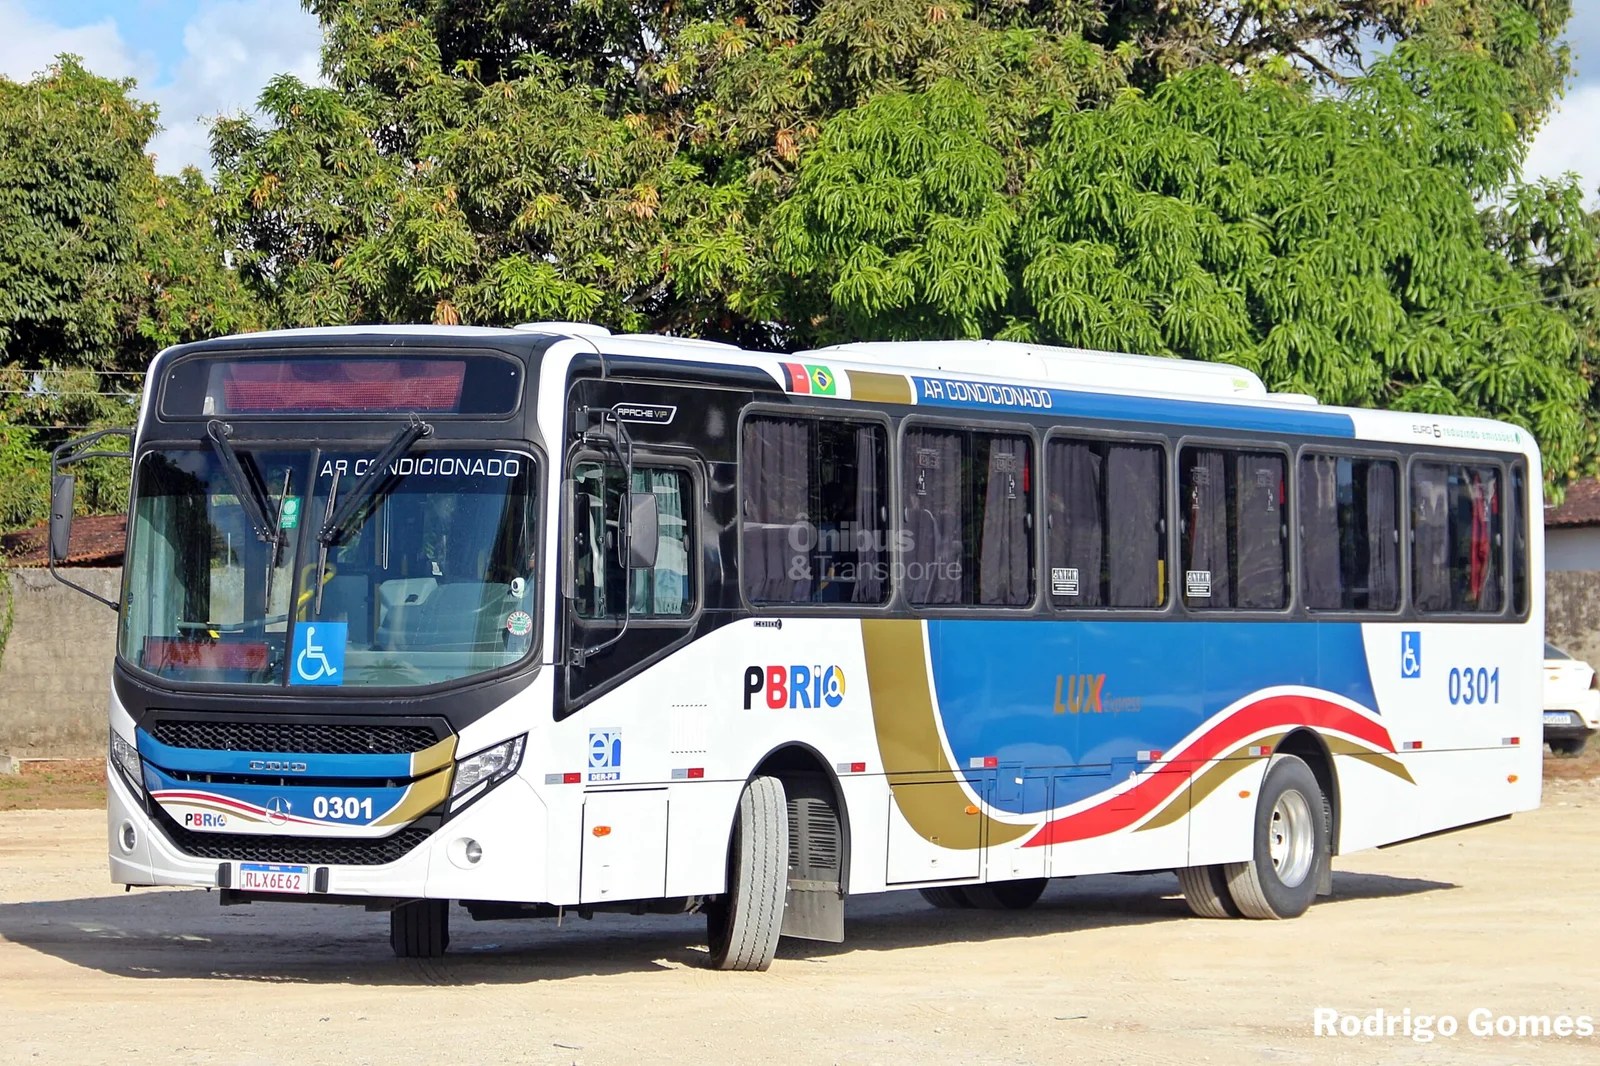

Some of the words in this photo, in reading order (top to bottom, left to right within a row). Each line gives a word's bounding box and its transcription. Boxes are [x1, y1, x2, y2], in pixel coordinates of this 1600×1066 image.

[923, 379, 944, 399] AR
[945, 381, 1052, 408] CONDICIONADO
[617, 408, 653, 417] APACHE
[654, 410, 668, 418] VIP
[1412, 424, 1432, 434] EURO
[1432, 424, 1441, 438] 6
[320, 459, 348, 477] AR
[1053, 673, 1106, 714] LUX
[1448, 667, 1499, 705] 0301
[591, 773, 618, 781] DER-PB
[312, 796, 373, 820] 0301
[246, 872, 301, 890] RLX6E62
